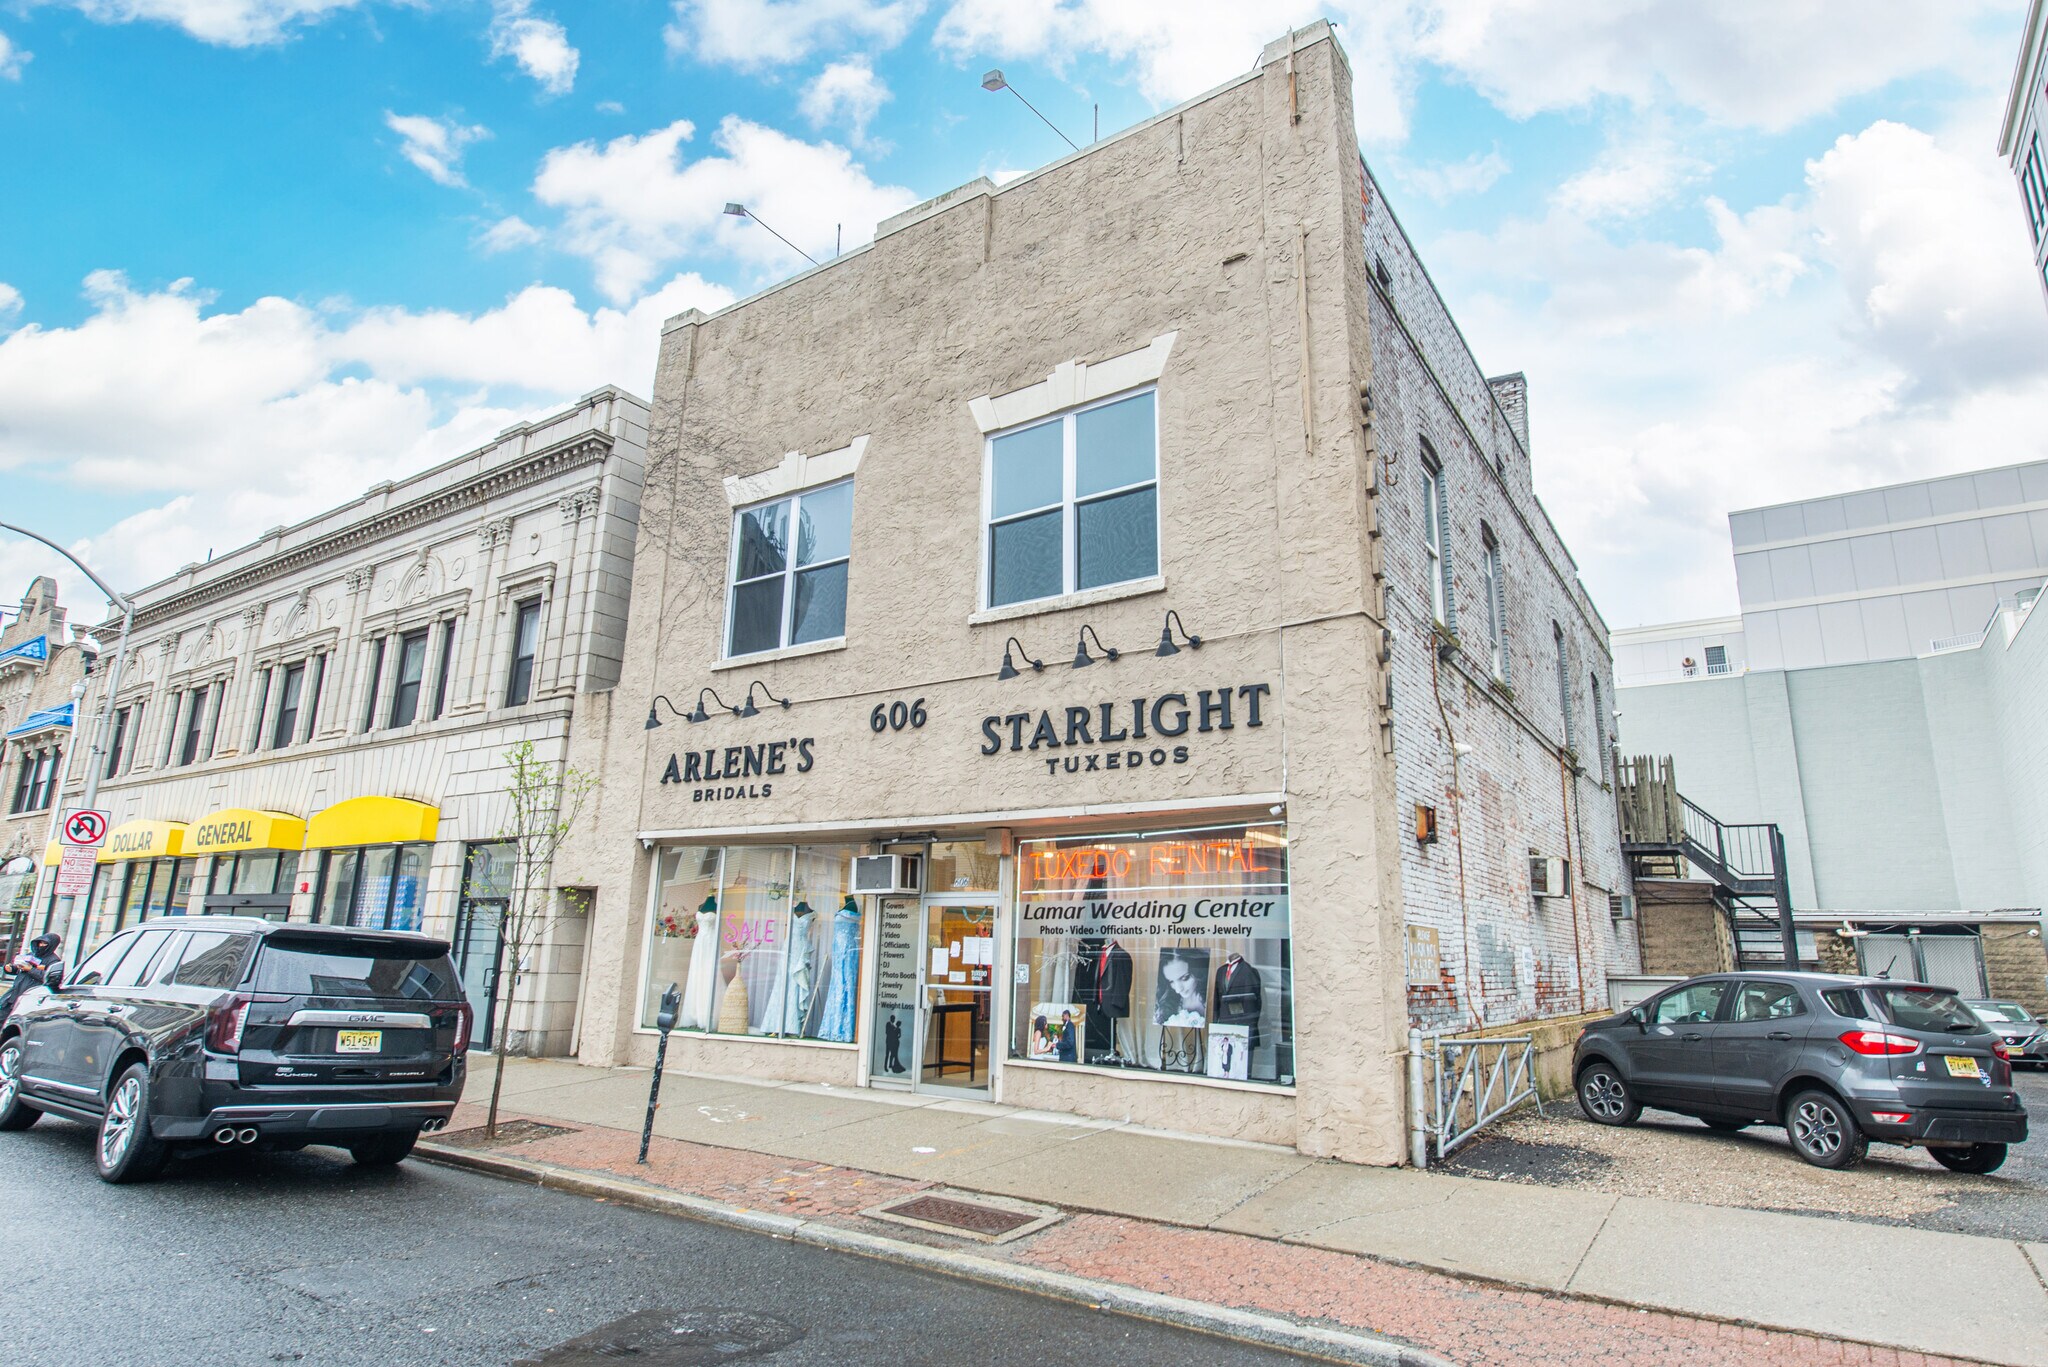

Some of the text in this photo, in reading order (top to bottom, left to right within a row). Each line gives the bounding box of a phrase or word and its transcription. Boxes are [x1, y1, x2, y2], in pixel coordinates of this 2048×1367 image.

[870, 698, 927, 732] 606
[981, 683, 1270, 755] STARLIGHT
[660, 737, 815, 784] ARLENE'S
[1046, 746, 1189, 774] TUXEDOS
[693, 783, 772, 802] BRIDALS
[112, 831, 153, 853] DOLLAR
[197, 820, 252, 846] GENERAL
[63, 858, 76, 867] NO
[1029, 843, 1269, 880] TUXEDO RENTAL
[1023, 899, 1275, 924] Lamar Wedding Center
[724, 913, 776, 943] SALE
[884, 931, 901, 939] Video
[1039, 924, 1252, 937] Photo Video Officiants DJ Flowers Jewelry
[883, 941, 911, 949] Officiants
[883, 951, 905, 959] Flowers
[881, 981, 903, 990] Jewelry
[881, 991, 898, 999] Limos
[880, 1001, 901, 1010] Weight
[348, 1014, 385, 1023] GMC
